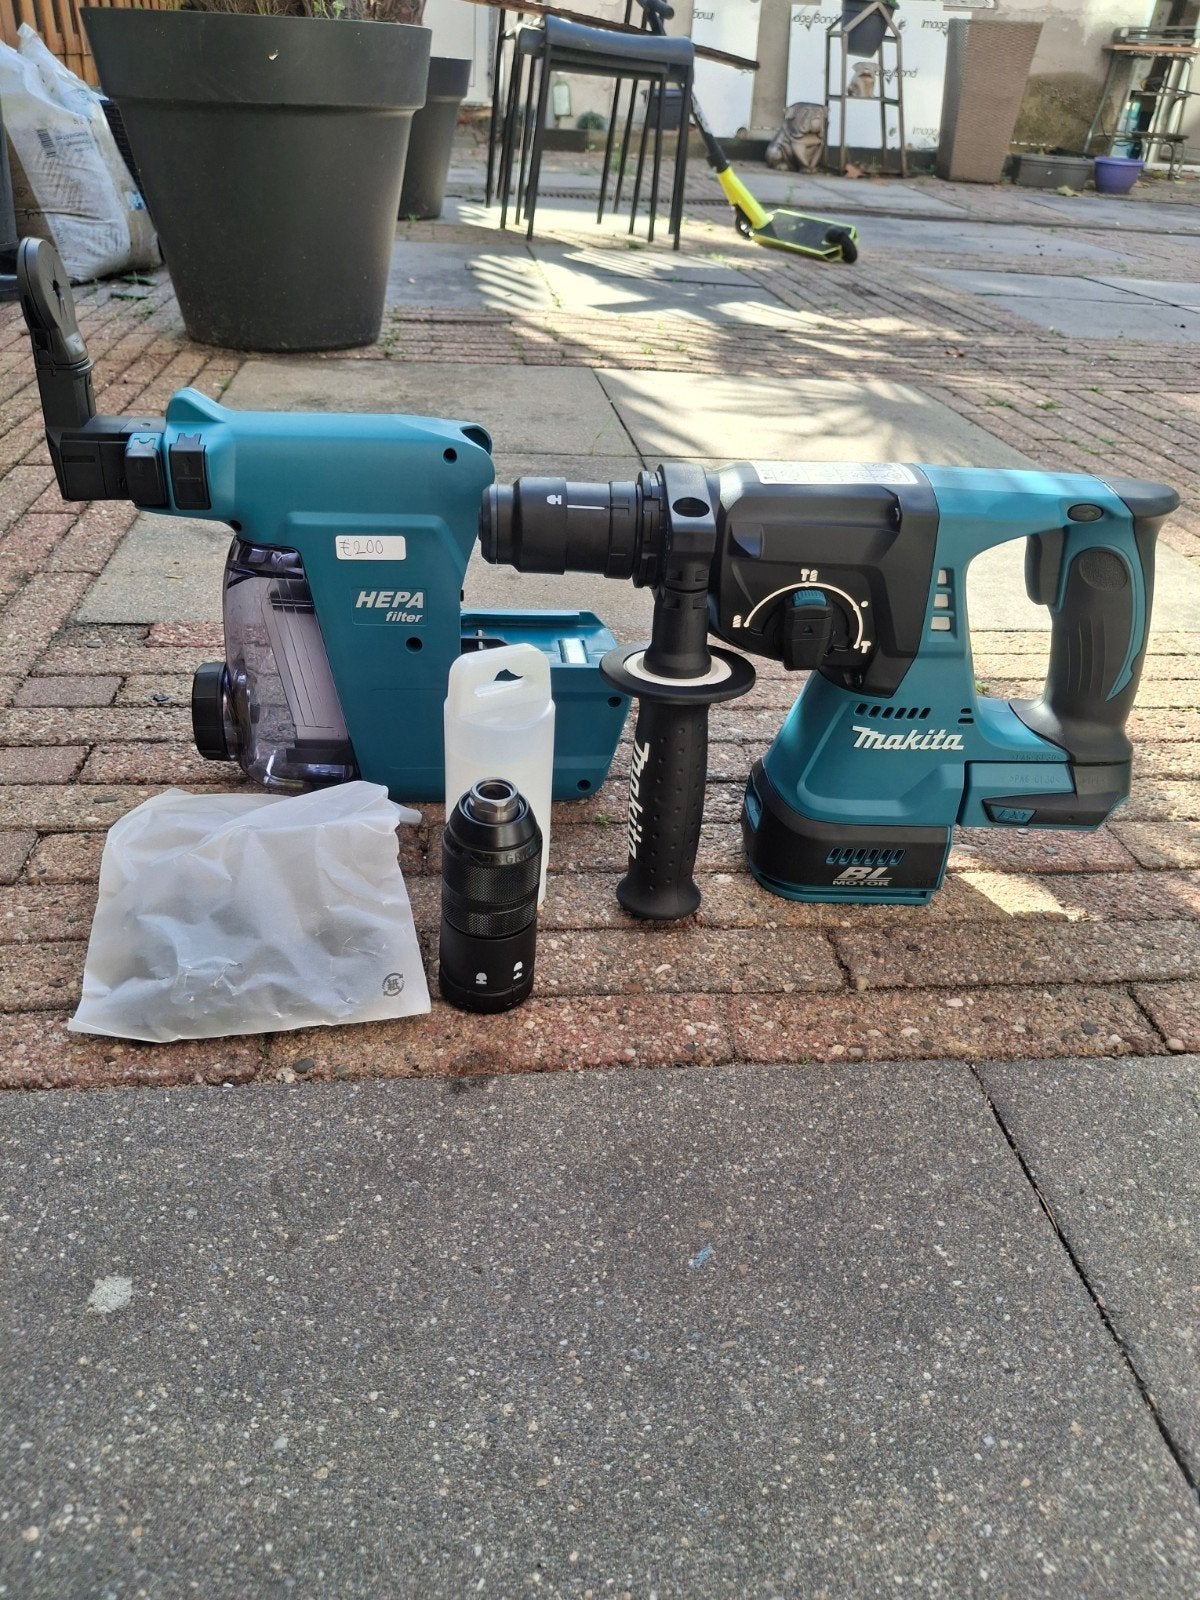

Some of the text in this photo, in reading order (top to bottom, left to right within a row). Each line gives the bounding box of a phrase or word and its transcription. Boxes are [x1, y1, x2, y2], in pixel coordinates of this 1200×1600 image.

[355, 591, 424, 609] HEPA
[385, 611, 423, 623] filter
[834, 866, 893, 882] BL
